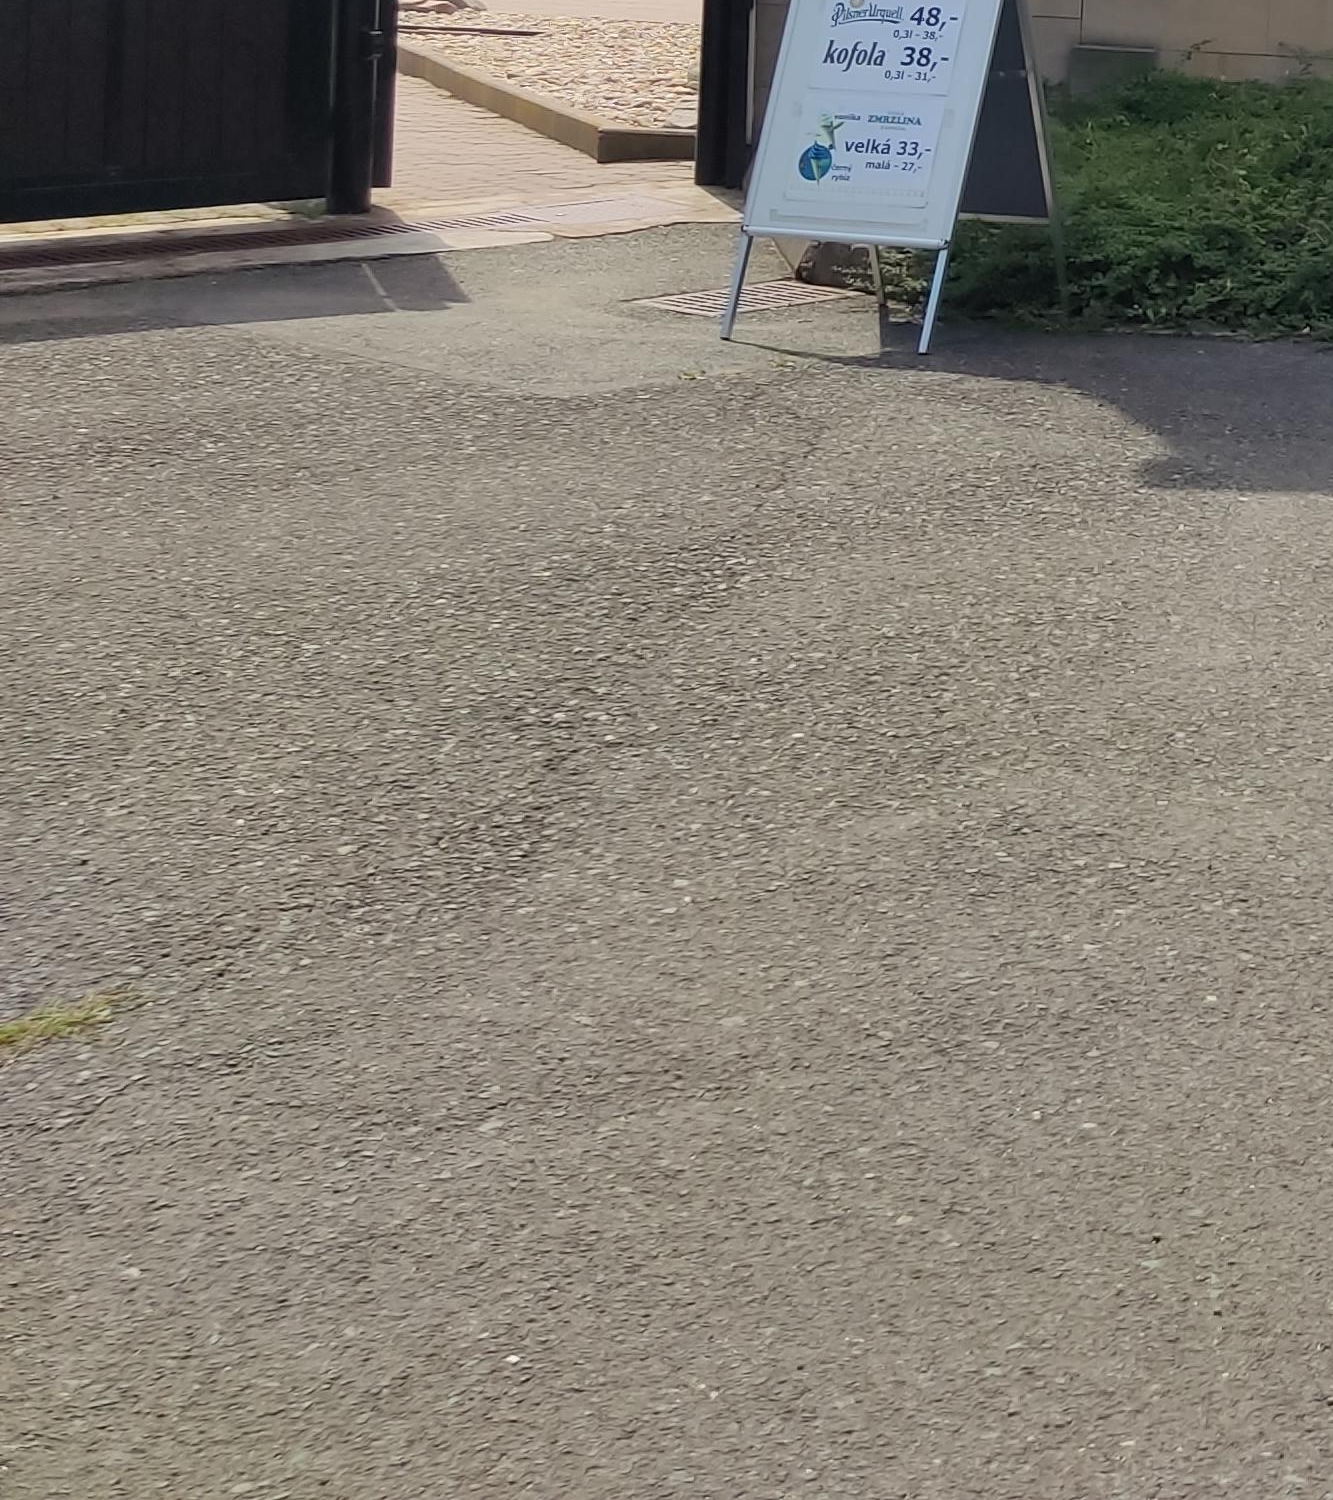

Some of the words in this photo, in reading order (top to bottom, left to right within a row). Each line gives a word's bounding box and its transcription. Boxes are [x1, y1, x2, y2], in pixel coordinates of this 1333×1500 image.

[831, 2, 869, 27] Pilsner
[868, 2, 904, 24] Urquell
[910, 6, 958, 31] 48,-
[823, 40, 886, 72] kofola
[900, 47, 949, 71] 38,-
[867, 115, 922, 126] ZMRZLINA
[845, 138, 891, 155] velká
[896, 140, 932, 160] 33,-
[865, 160, 890, 171] malá
